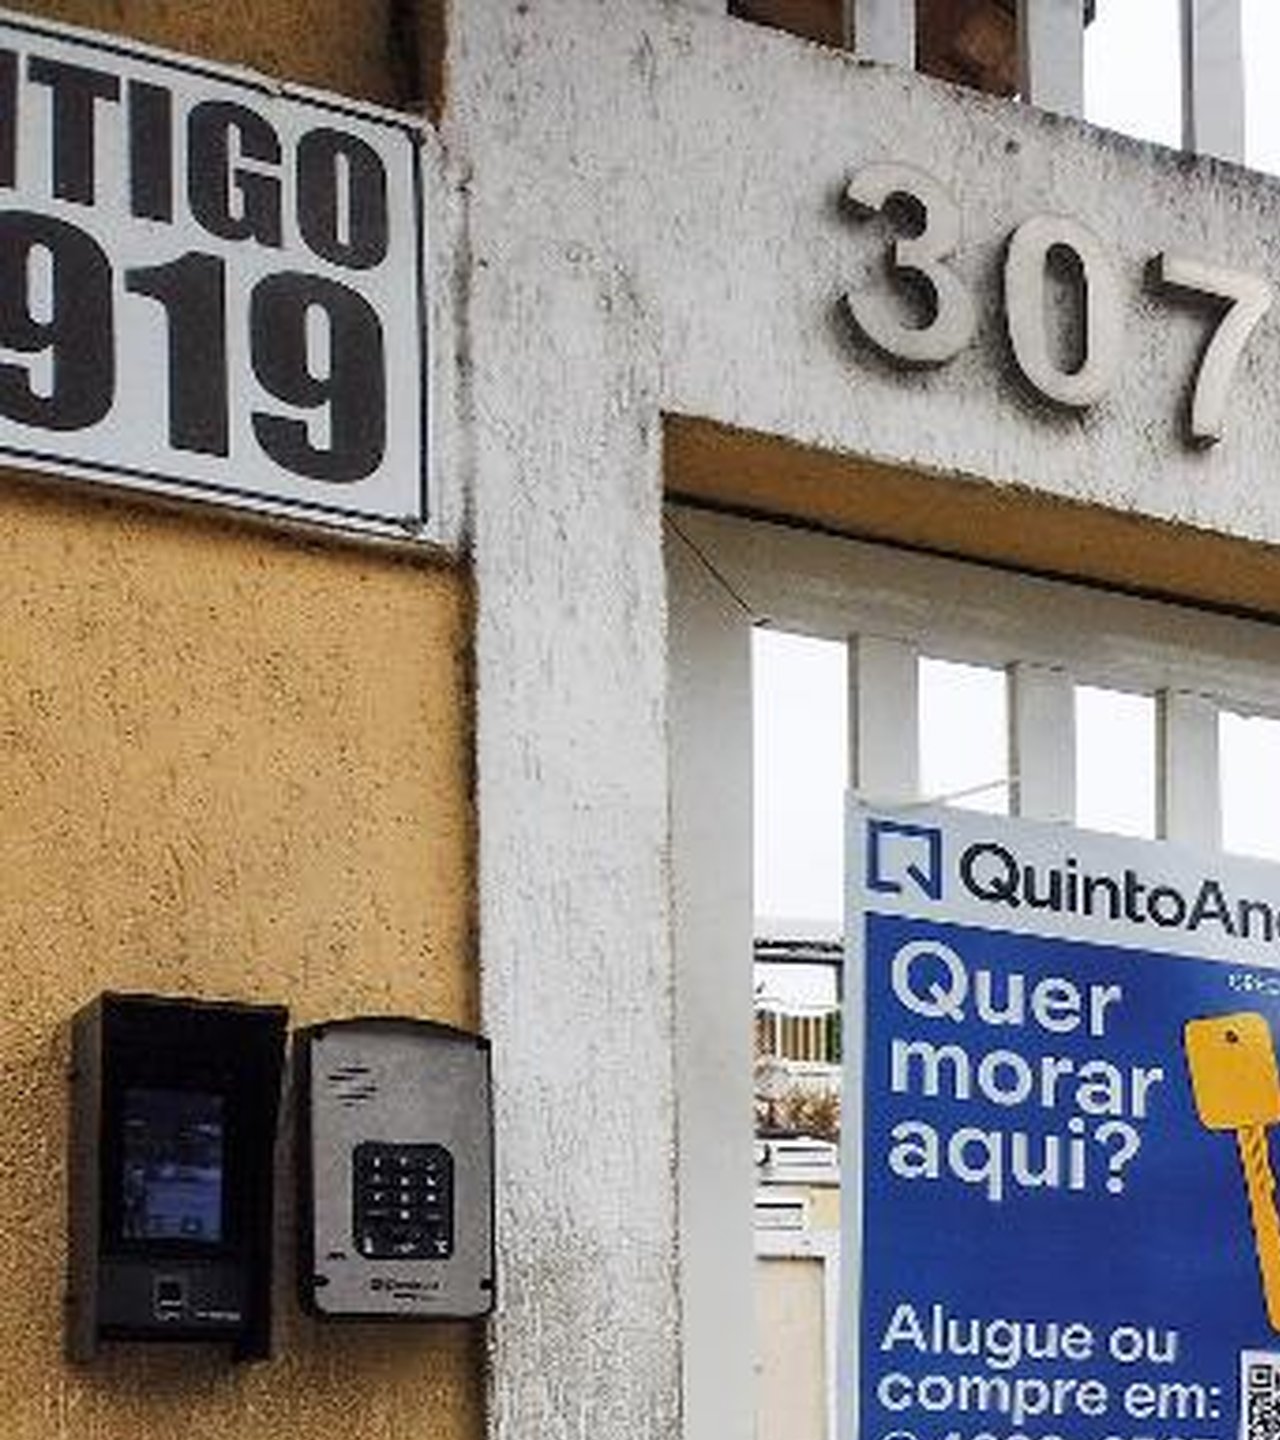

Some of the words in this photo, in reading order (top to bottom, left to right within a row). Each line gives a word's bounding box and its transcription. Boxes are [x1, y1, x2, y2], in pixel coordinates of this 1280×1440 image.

[0, 48, 390, 270] TIGO
[890, 939, 1122, 1037] Quer
[890, 1037, 1164, 1119] morar
[888, 1117, 1141, 1201] aqui?
[879, 1303, 1094, 1369] Alugue
[1108, 1325, 1177, 1363] ou
[876, 1370, 1108, 1425] compre
[1123, 1381, 1222, 1420] em:
